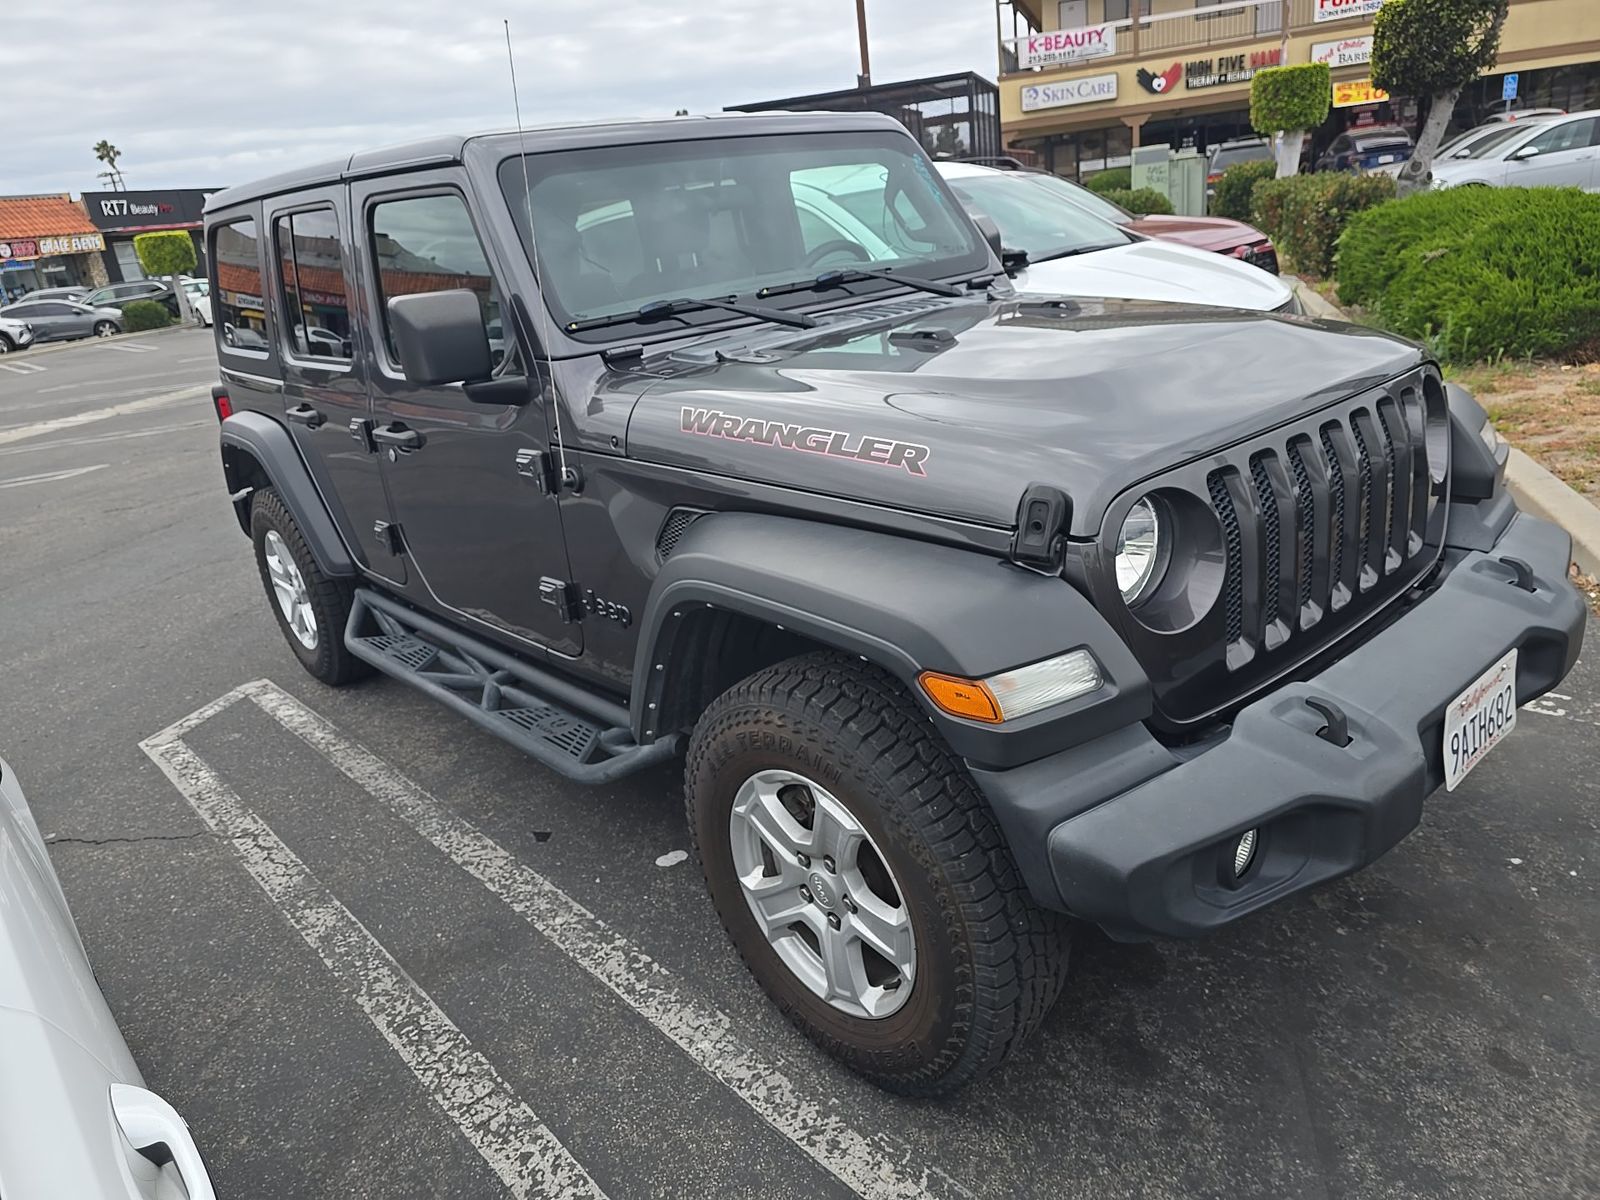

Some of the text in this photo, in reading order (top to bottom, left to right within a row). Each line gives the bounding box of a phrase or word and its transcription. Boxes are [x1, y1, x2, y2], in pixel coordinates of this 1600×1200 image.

[1027, 27, 1106, 54] K-BEAUTY
[1185, 58, 1213, 76] HIGH
[1218, 54, 1246, 72] FIVE
[1042, 80, 1114, 103] SKIN CARE
[100, 199, 127, 217] RT7
[130, 203, 158, 217] Beauty
[680, 406, 931, 478] WRANGLER
[580, 588, 632, 629] Jeep
[1451, 684, 1512, 777] 9AIH682
[735, 728, 843, 785] TERRAIN
